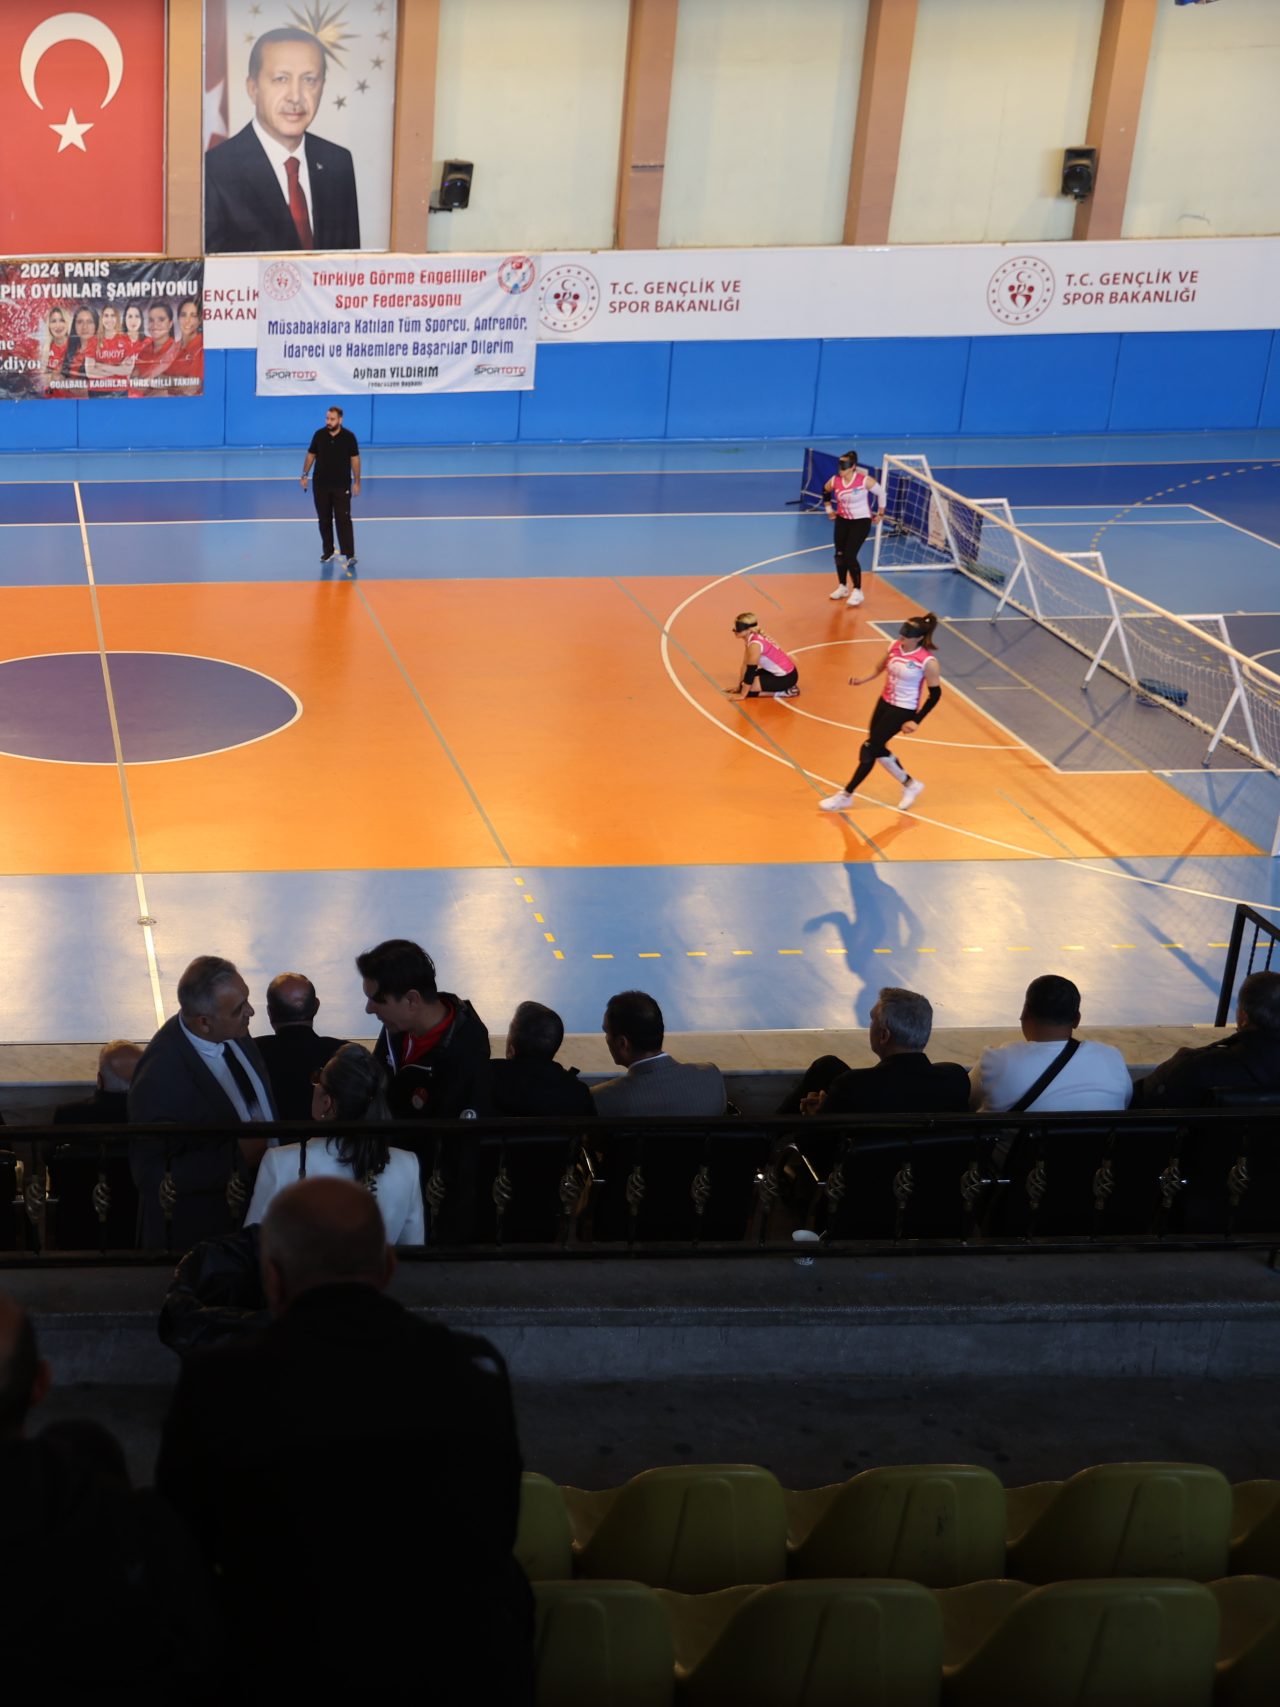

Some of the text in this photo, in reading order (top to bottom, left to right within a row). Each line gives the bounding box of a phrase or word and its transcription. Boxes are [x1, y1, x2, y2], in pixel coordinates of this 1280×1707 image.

[21, 259, 110, 279] 2024 PARİS
[312, 270, 365, 287] Türkiye
[370, 269, 415, 286] Görme
[420, 268, 487, 286] Engelliler
[1065, 269, 1199, 287] T.C. GENÇLİK VE
[31, 282, 102, 299] OYUNLAR
[107, 278, 198, 301] ŞAMPİYONU
[204, 286, 259, 305] ENÇLİK
[609, 277, 741, 297] T.C. GENÇLİK VE
[1062, 287, 1197, 305] SPOR BAKANLIĞI
[335, 292, 462, 310] Spor Federasyonu
[608, 296, 741, 314] SPOR BAKANLIĞI
[203, 308, 257, 320] BAKAN
[268, 319, 350, 336] Müsabakalara
[354, 318, 395, 334] Katılan
[398, 317, 421, 333] Tüm
[329, 344, 342, 357] ve
[346, 341, 409, 357] Hakemlere
[412, 340, 468, 360] Başarılar
[471, 338, 514, 355] Dilerim
[353, 365, 439, 380] Ayhan YILDIRIM
[50, 378, 88, 389] GOALBALL
